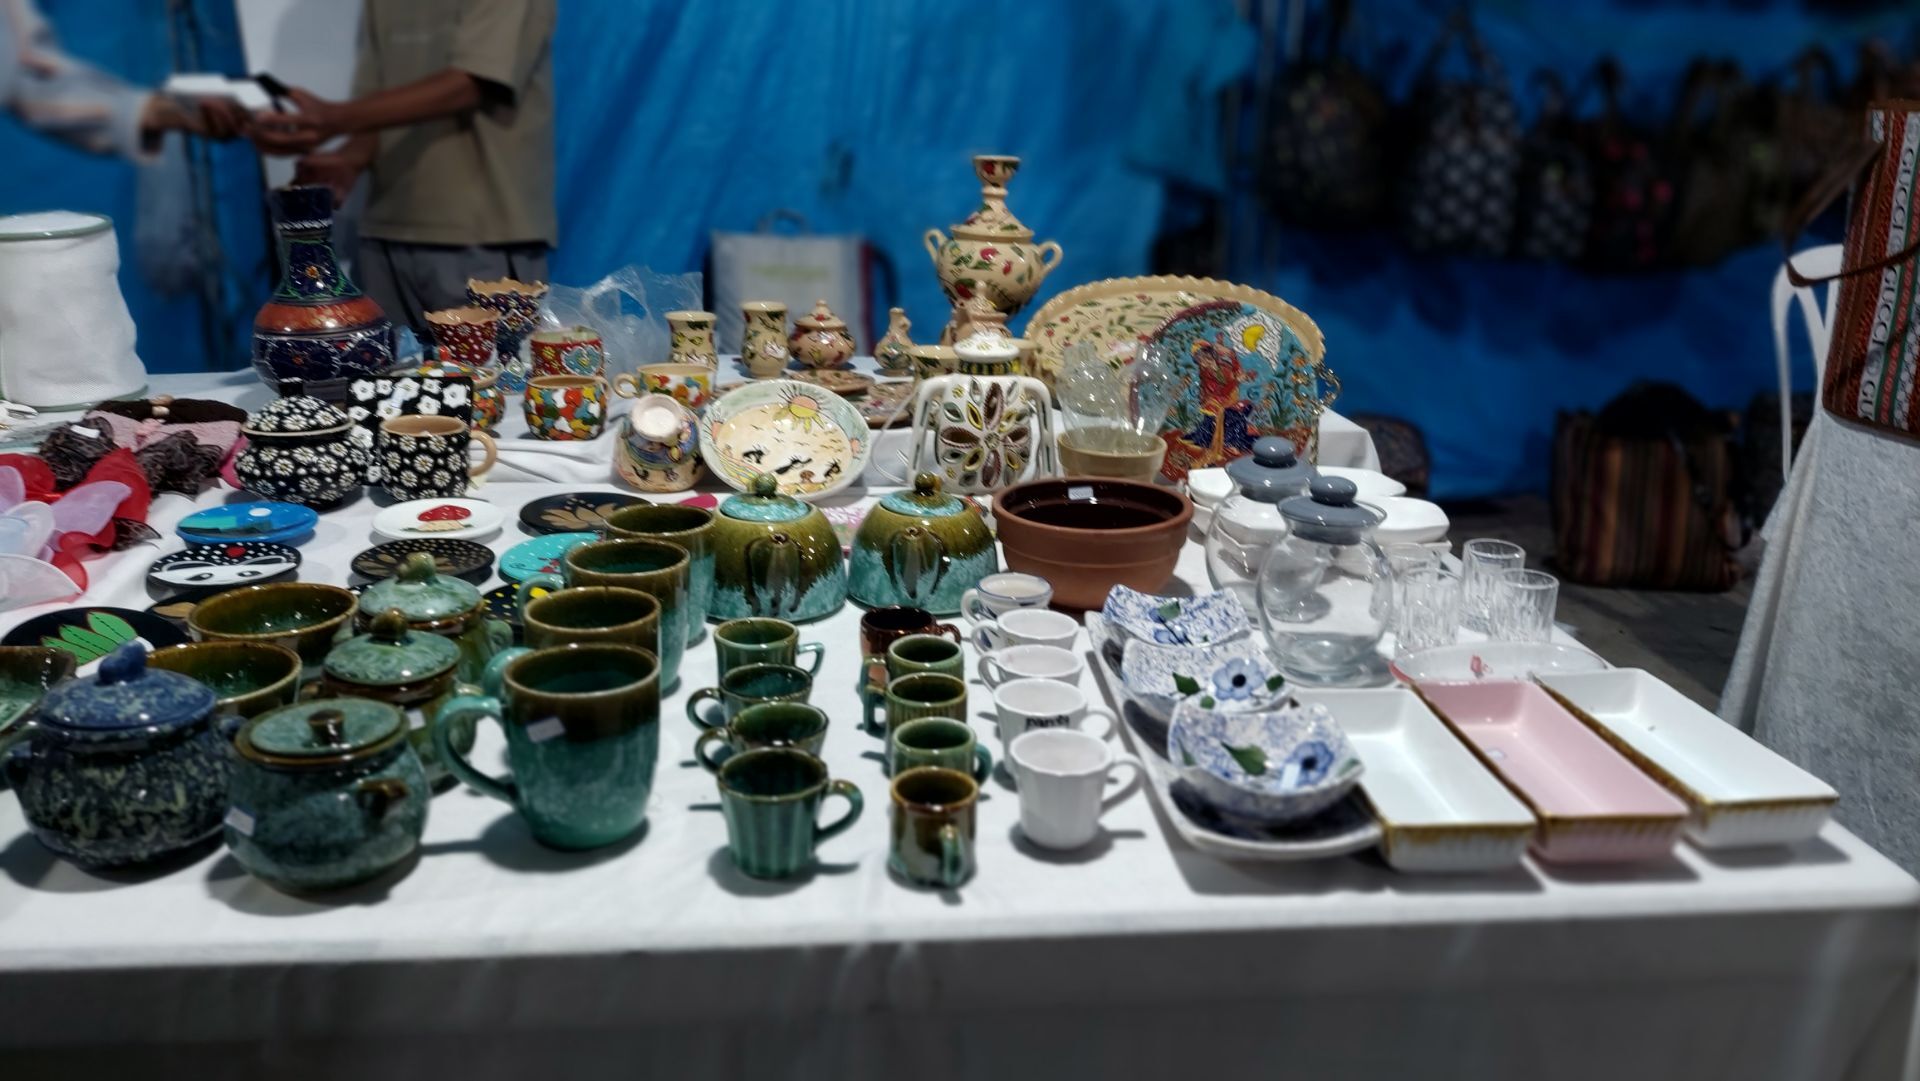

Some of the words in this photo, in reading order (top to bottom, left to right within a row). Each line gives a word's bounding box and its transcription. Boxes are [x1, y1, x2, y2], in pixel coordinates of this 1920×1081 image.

[1892, 148, 1914, 230] GUCCI
[1872, 266, 1897, 346] GUCCI
[1859, 380, 1876, 420] GU
